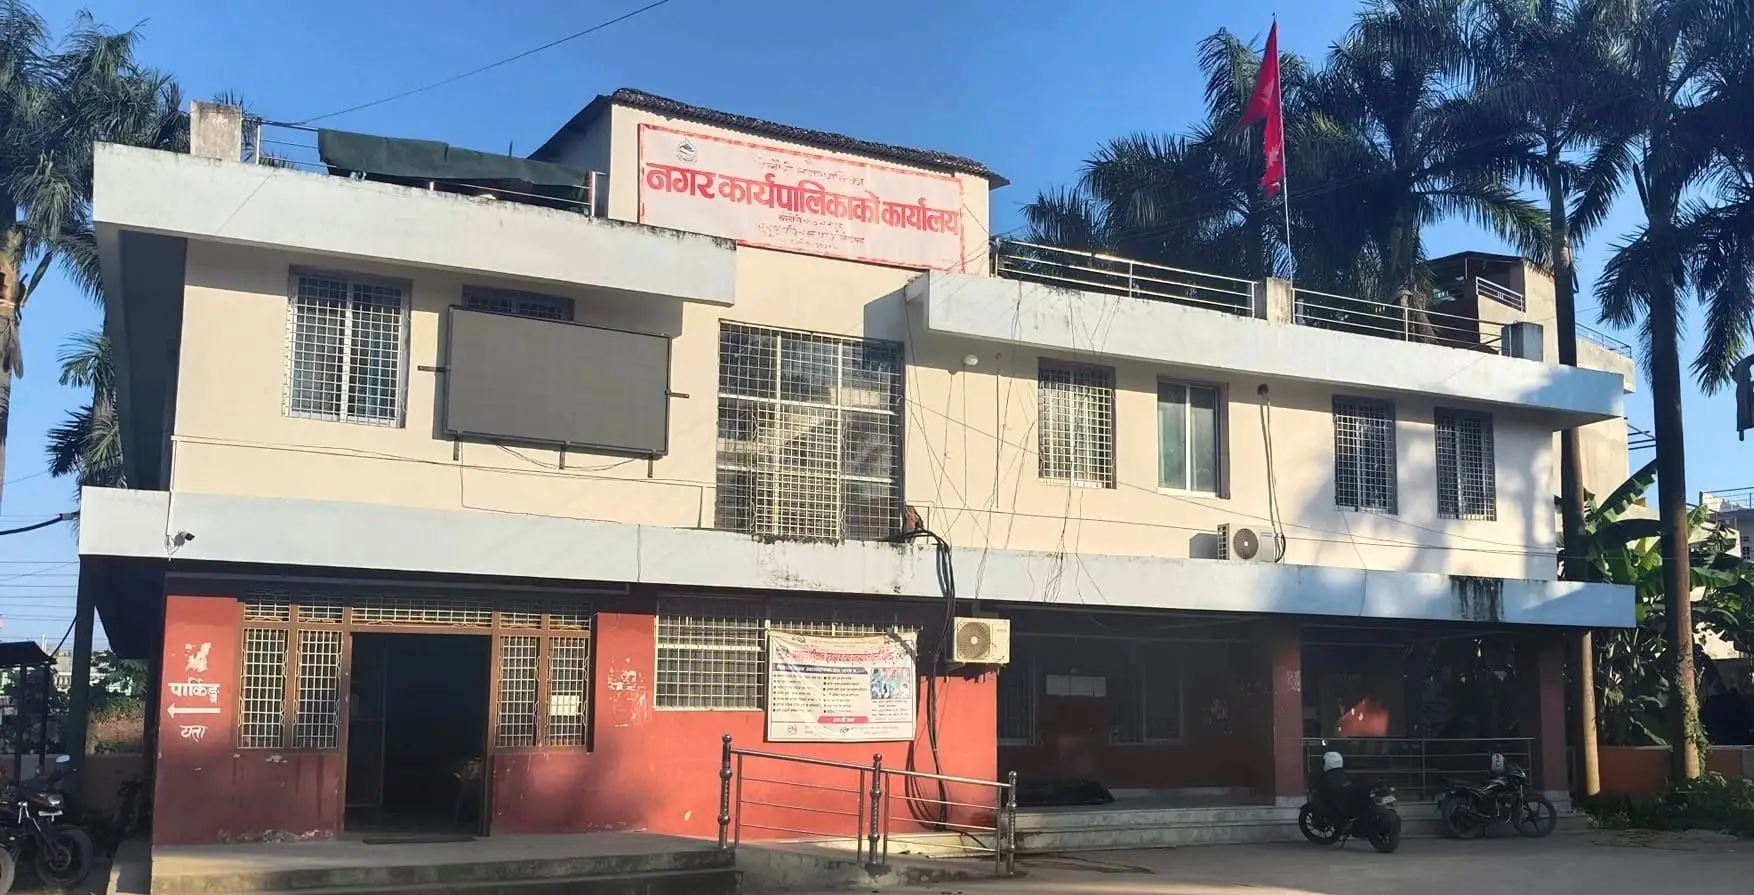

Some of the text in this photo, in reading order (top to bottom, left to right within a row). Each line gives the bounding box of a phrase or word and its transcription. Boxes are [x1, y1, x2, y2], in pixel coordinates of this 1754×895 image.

[646, 162, 718, 199] नगर
[718, 173, 880, 225] कार्यपालिकाको
[881, 197, 959, 235] कार्यालय
[180, 725, 209, 742] यता
